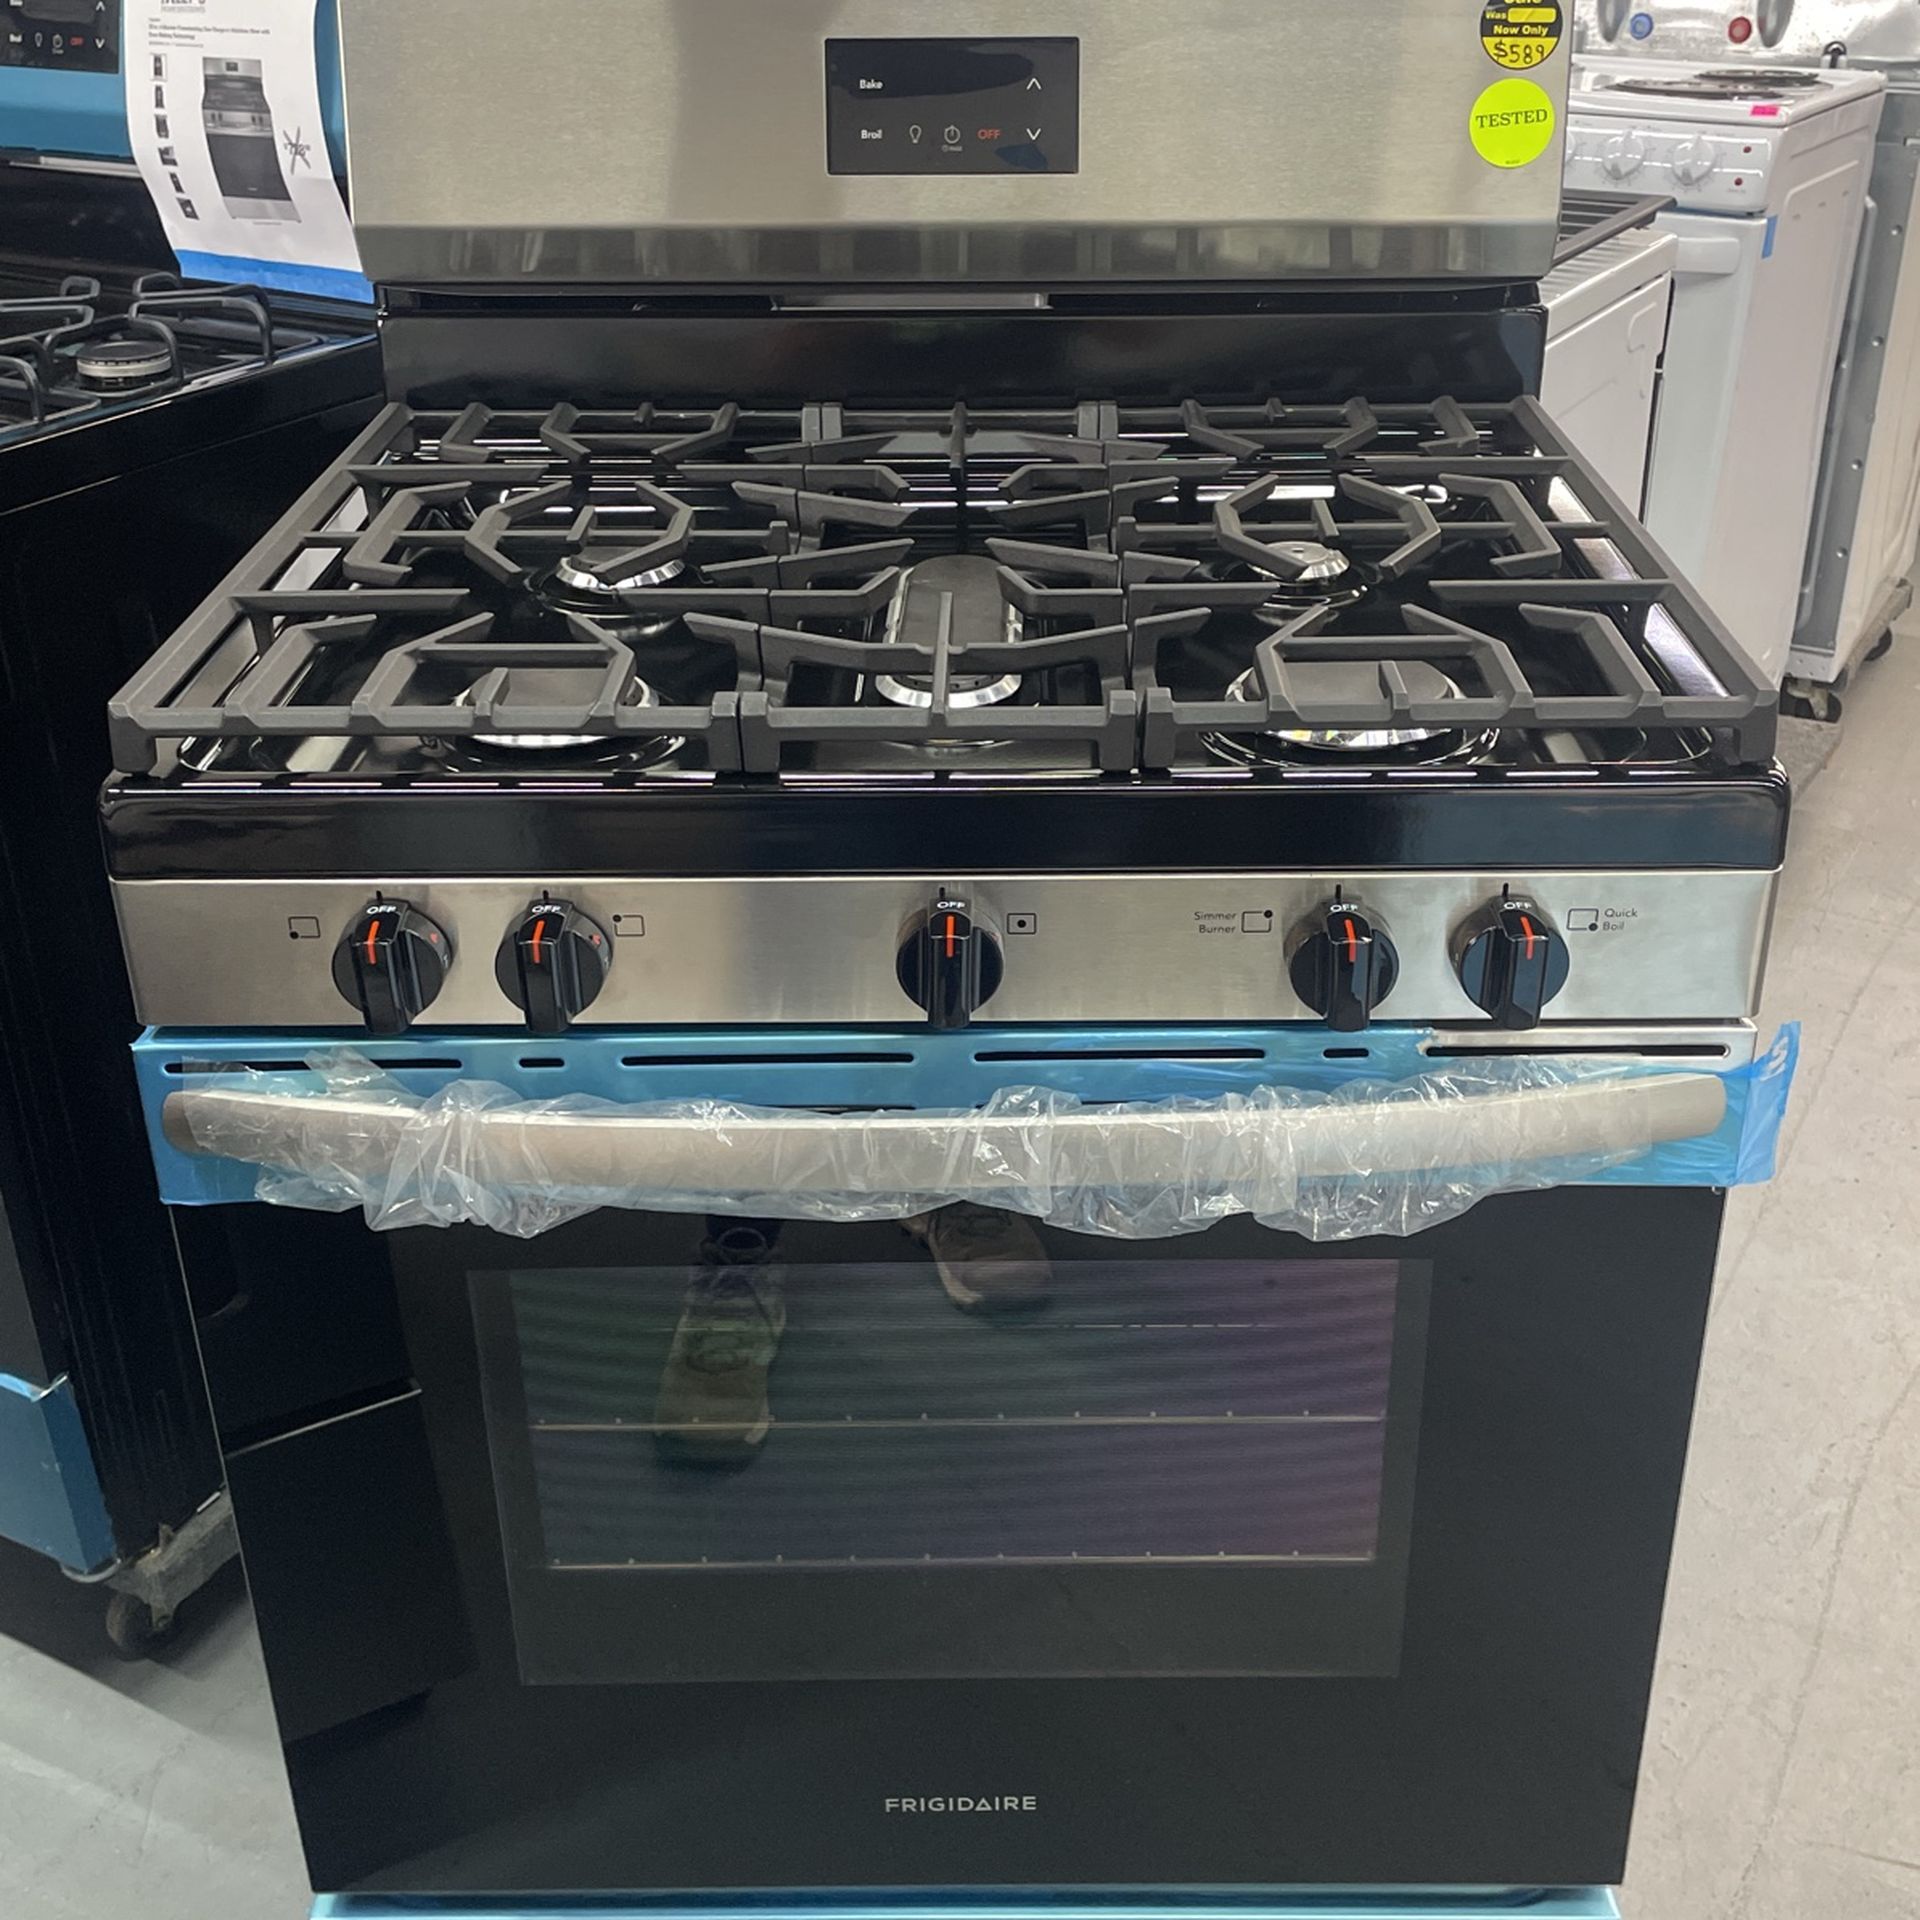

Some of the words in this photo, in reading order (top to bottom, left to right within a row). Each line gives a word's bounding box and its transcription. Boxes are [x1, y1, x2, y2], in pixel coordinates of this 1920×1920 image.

[1485, 11, 1507, 19] Was
[1493, 25, 1519, 34] Now
[1522, 25, 1549, 36] Only
[1493, 39, 1545, 64] $589
[859, 79, 884, 89] Bake
[1475, 108, 1548, 128] TESTED
[860, 129, 883, 139] Broil
[977, 129, 1001, 139] OFF
[366, 905, 397, 914] OFF
[531, 904, 562, 914] OFF
[937, 901, 966, 909] OFF
[1330, 904, 1359, 912] OFF
[1503, 901, 1532, 910] OFF
[1194, 911, 1237, 921] Simmer
[1604, 908, 1638, 918] Quick
[1199, 924, 1236, 934] Burner
[1602, 921, 1625, 931] Boil
[885, 1796, 1037, 1812] FRIGIDAIRE
